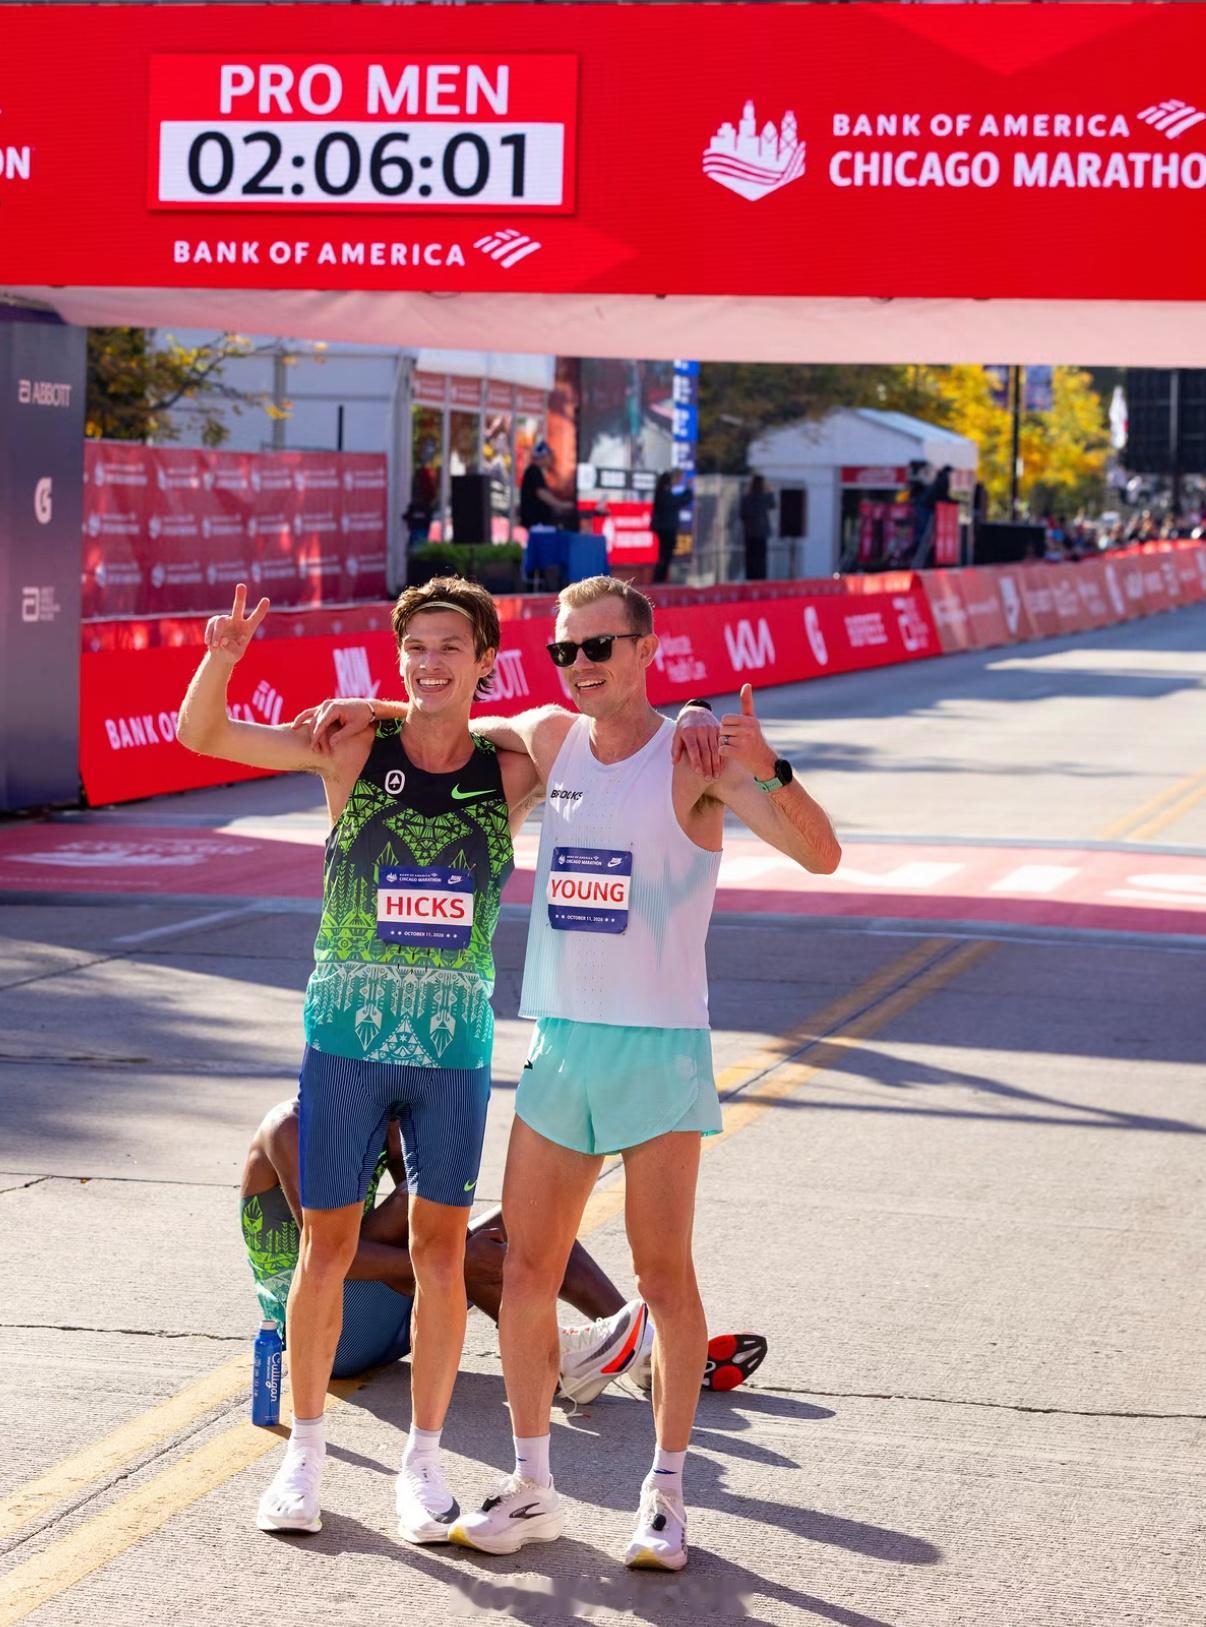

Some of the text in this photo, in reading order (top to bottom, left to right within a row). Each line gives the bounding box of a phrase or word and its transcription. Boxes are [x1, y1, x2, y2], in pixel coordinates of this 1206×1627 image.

[220, 64, 509, 115] PRO MEN
[834, 114, 1130, 137] BANK OF AMERICA
[0, 146, 30, 180] N
[187, 130, 526, 197] 02:06:01
[829, 152, 1000, 188] CHICAGO
[174, 240, 465, 266] BANK OF AMERICA
[105, 715, 160, 750] BANK
[385, 895, 465, 919] HICKS
[551, 879, 625, 903] YOUNG
[264, 1352, 281, 1402] Culligan
